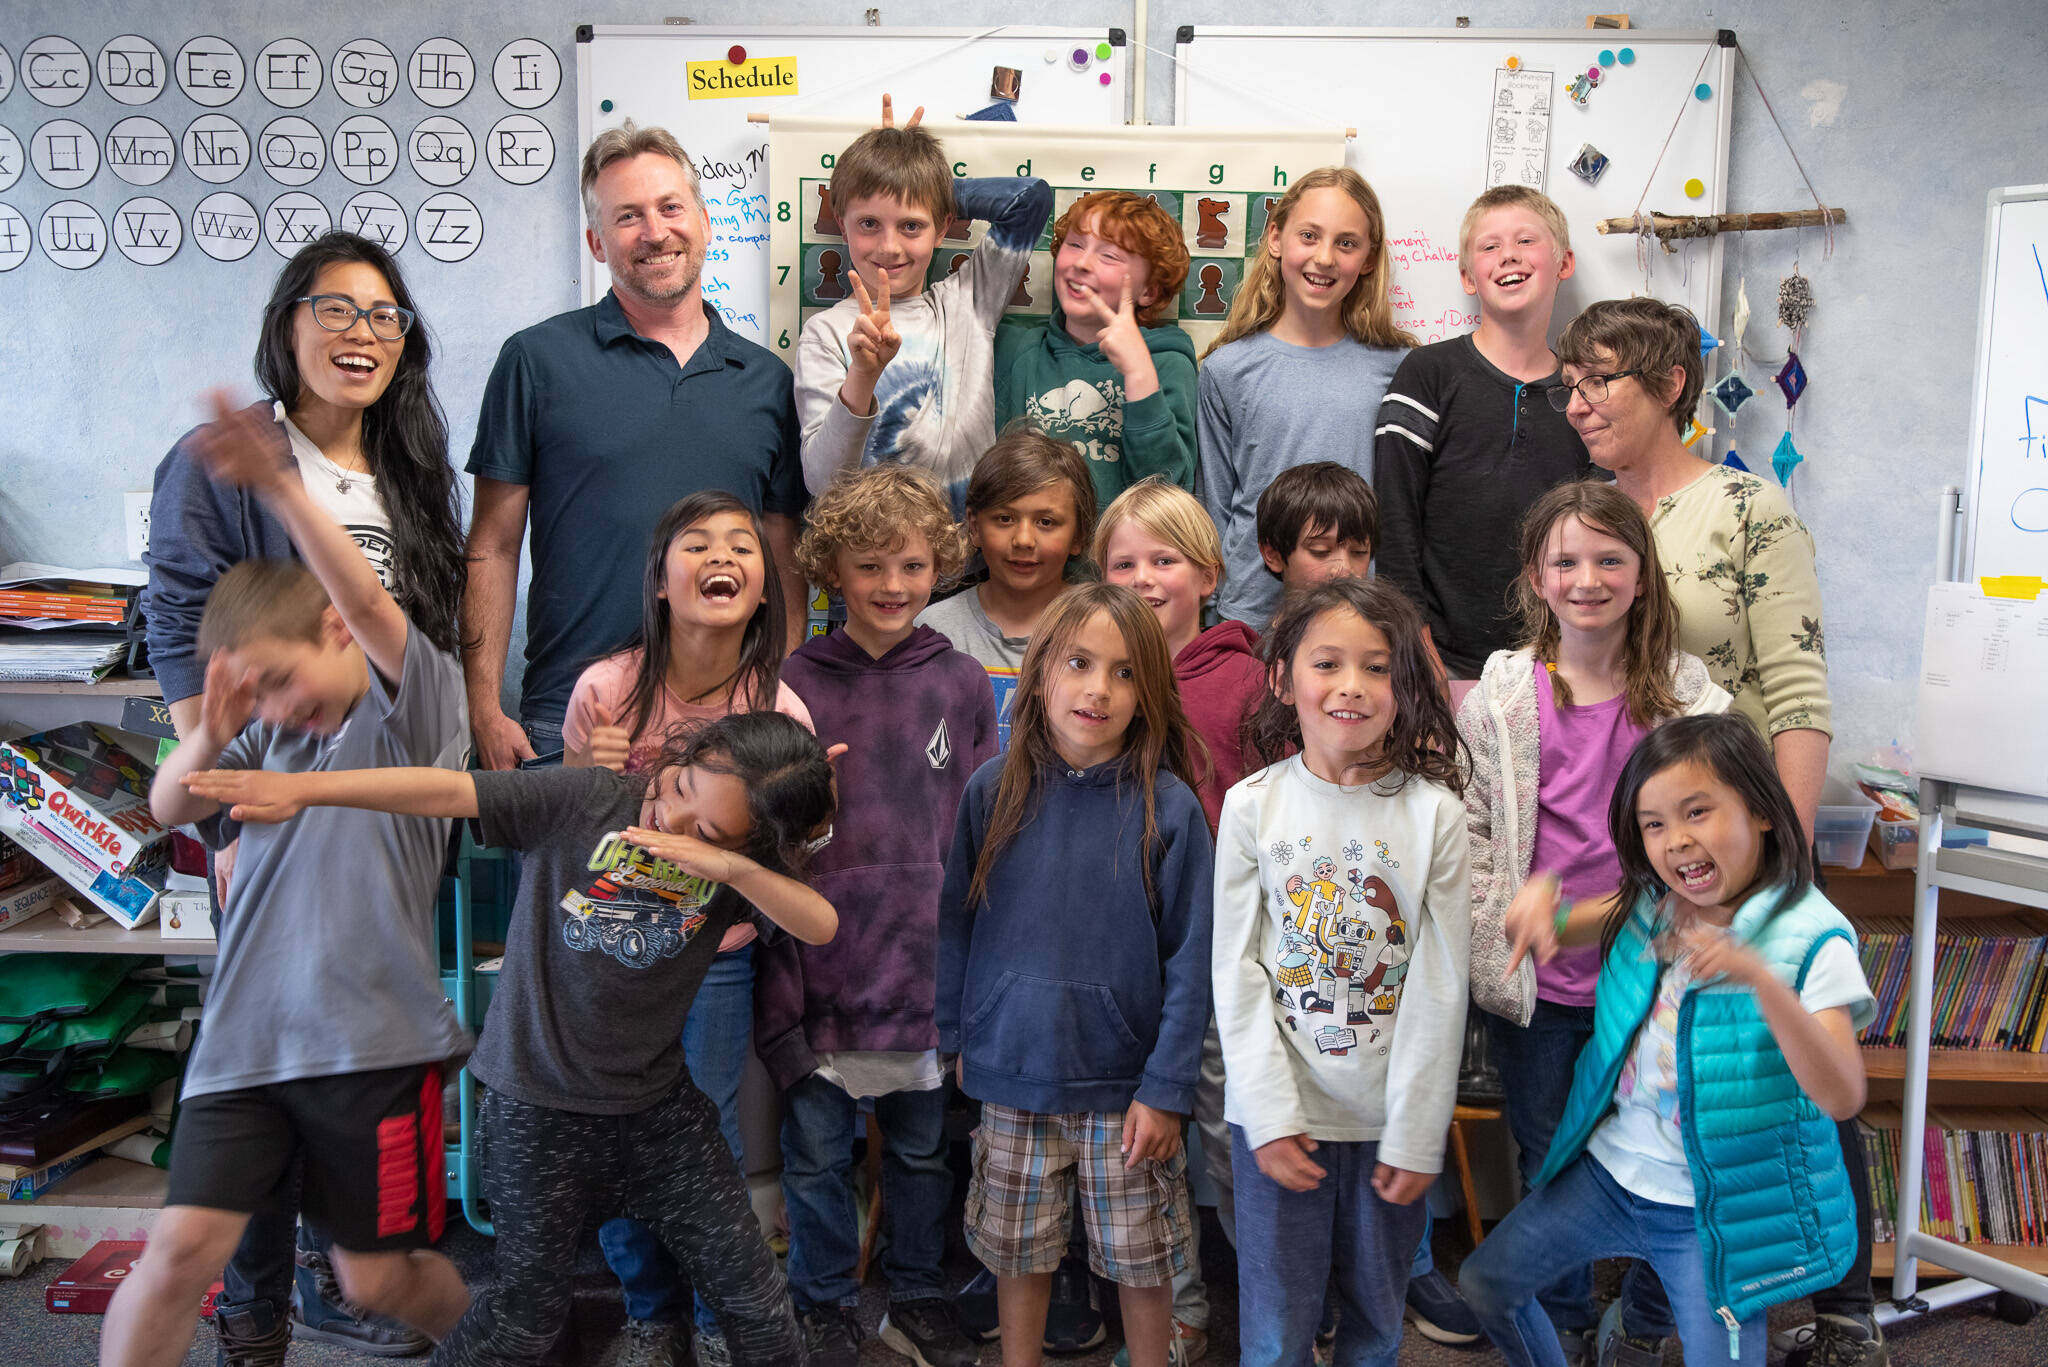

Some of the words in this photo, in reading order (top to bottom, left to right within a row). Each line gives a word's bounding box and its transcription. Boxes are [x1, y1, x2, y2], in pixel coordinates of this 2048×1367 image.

[29, 53, 80, 88] Cc
[107, 51, 155, 87] Dd
[188, 52, 231, 88] Ee
[268, 55, 308, 89] Ff
[341, 52, 387, 104] Gg
[419, 53, 463, 89] Hh
[512, 55, 539, 90] Ii
[692, 64, 794, 91] Schedule
[112, 137, 169, 164] Mm
[194, 131, 238, 165] Nn
[266, 135, 317, 169] Oo
[345, 132, 386, 181] Pp
[417, 132, 466, 175] Qq
[500, 131, 540, 166] Rr
[820, 153, 835, 169] a
[952, 161, 968, 178] c
[1016, 159, 1032, 177] d
[1080, 166, 1096, 182] e
[1148, 163, 1157, 184] f
[1208, 164, 1224, 185] g
[1273, 165, 1287, 186] h
[777, 201, 791, 222] 8
[51, 216, 95, 251] Uu
[124, 213, 168, 247] Vv
[200, 211, 252, 239] Ww
[277, 208, 317, 242] Xx
[427, 209, 470, 243] Zz
[777, 266, 791, 286] 7
[777, 329, 790, 349] 6
[48, 790, 122, 857] Qwirkle
